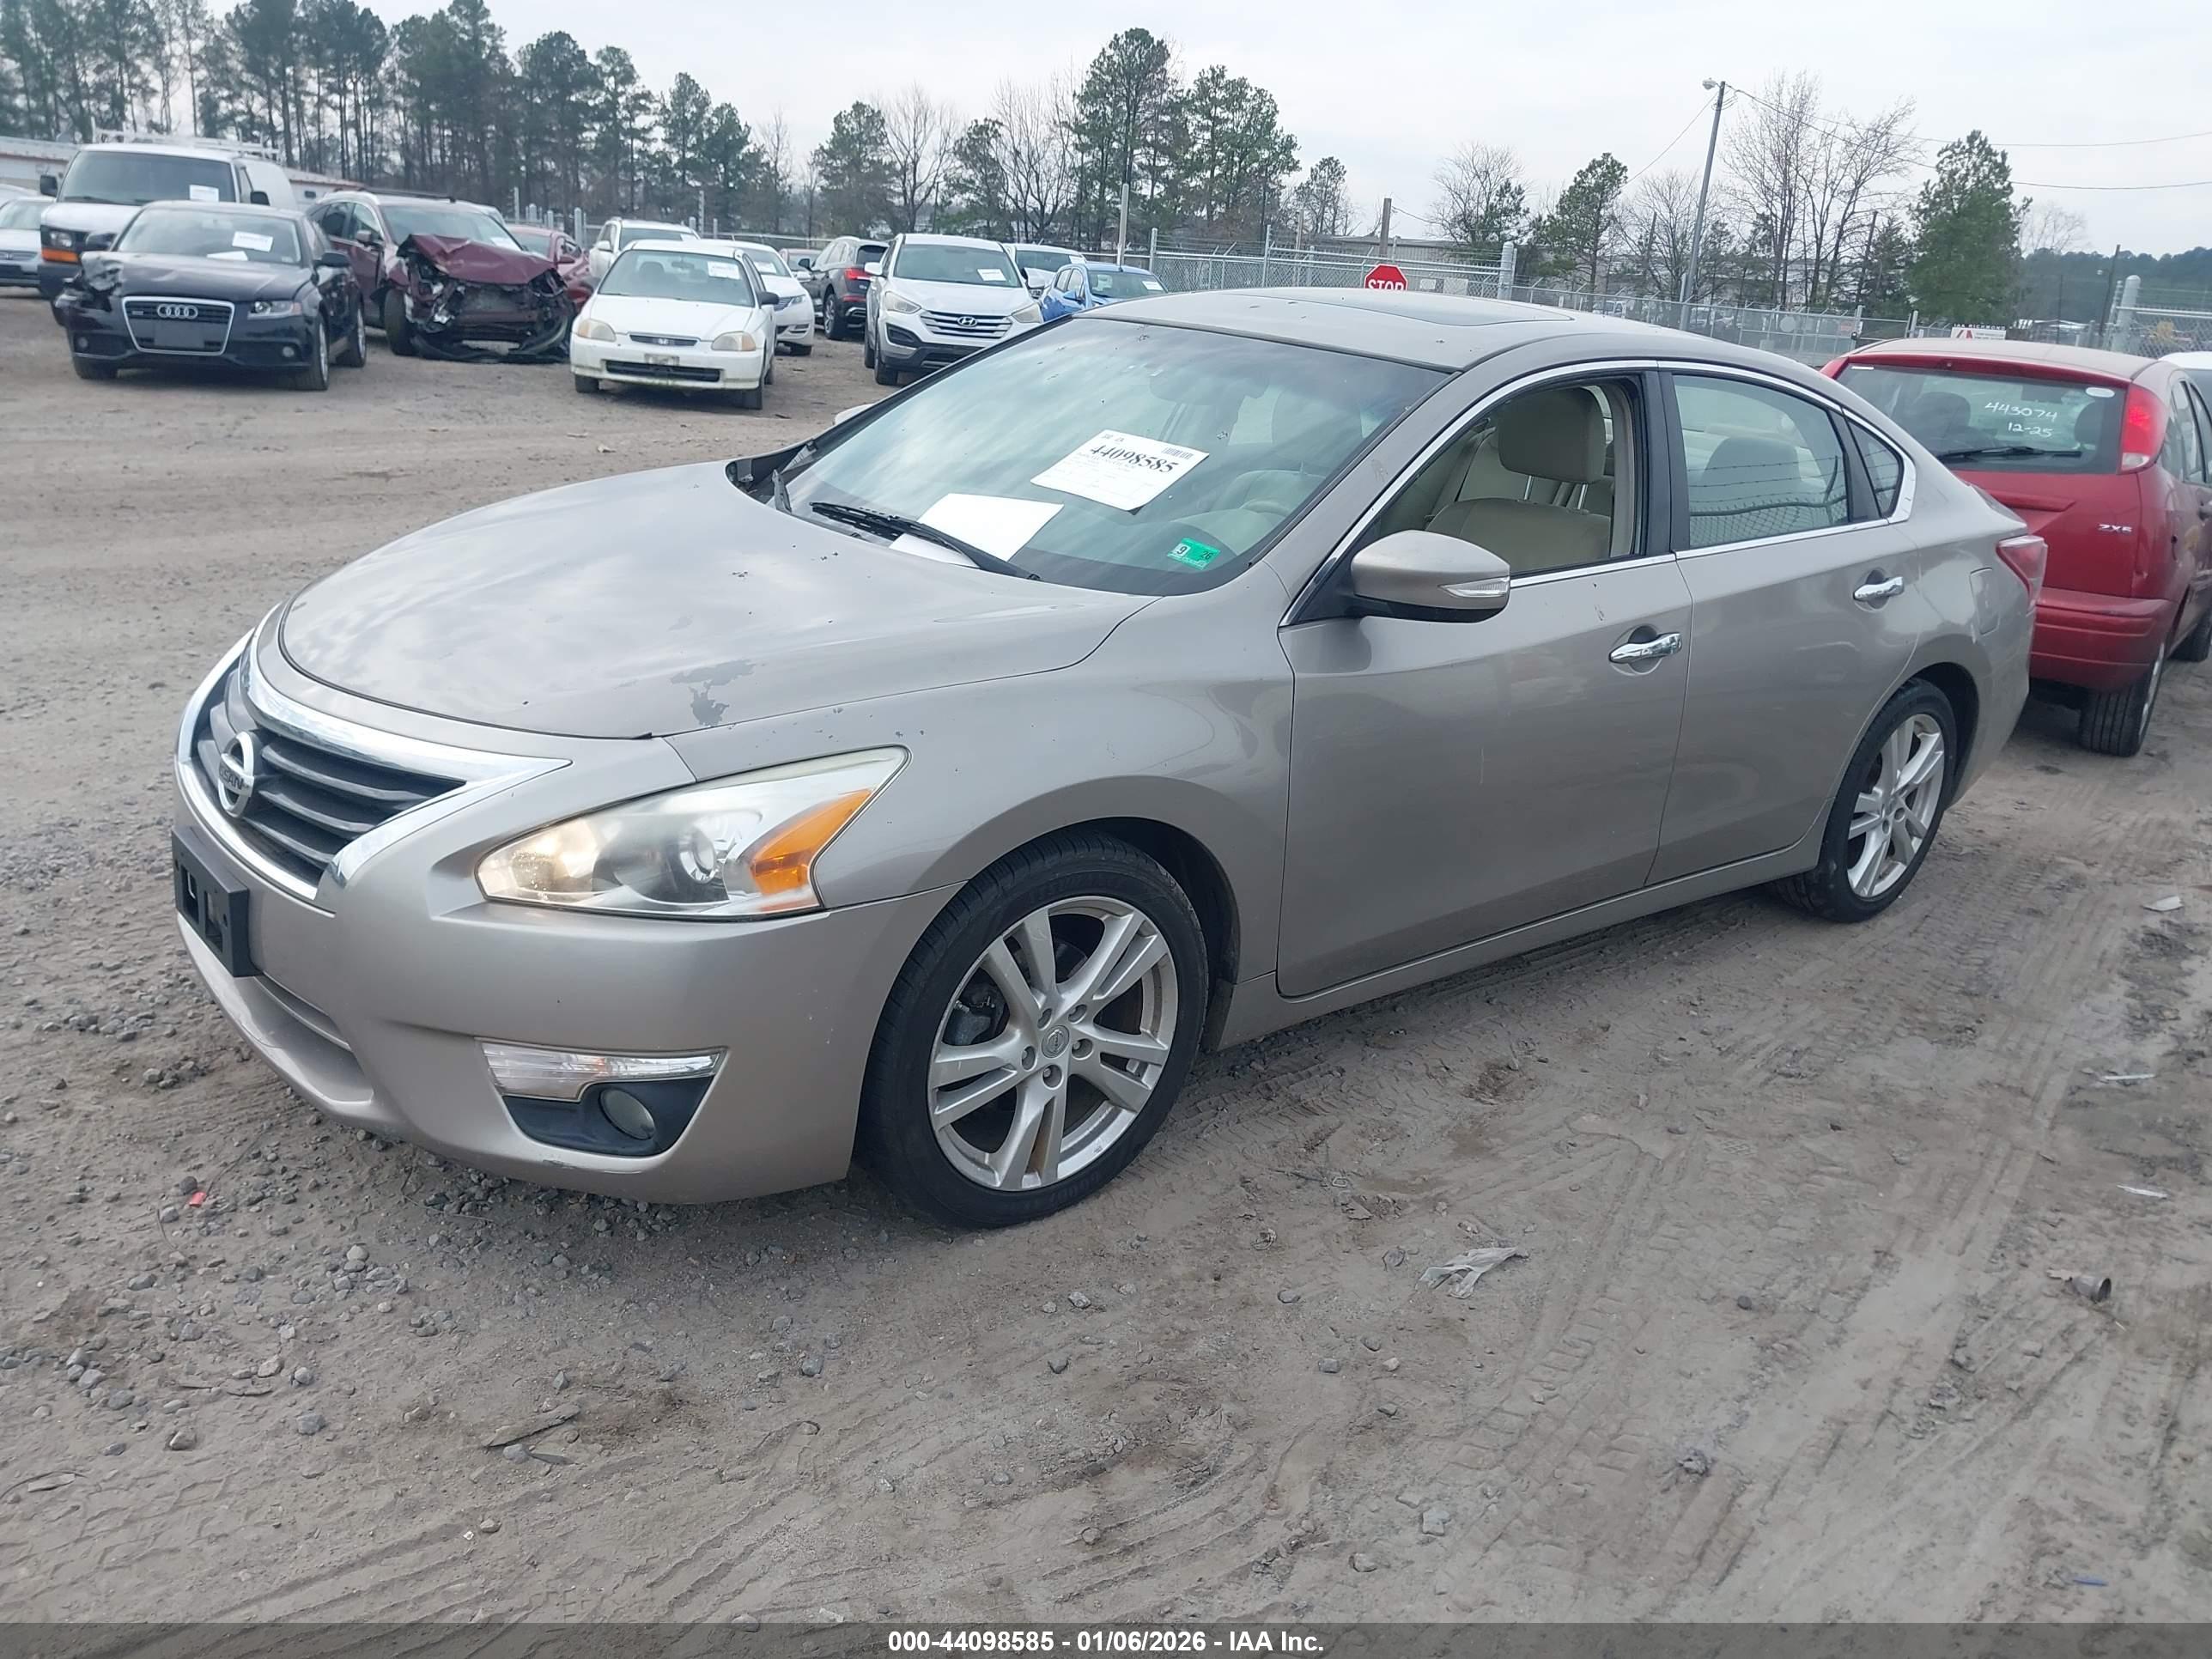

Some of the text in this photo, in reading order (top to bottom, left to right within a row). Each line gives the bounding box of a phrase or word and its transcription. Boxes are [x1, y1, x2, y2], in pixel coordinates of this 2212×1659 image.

[1368, 279, 1404, 290] STOP
[1984, 402, 2057, 422] 443074
[2008, 422, 2053, 437] 12-25
[1090, 445, 1179, 473] 44098585
[1176, 546, 1188, 555] 9
